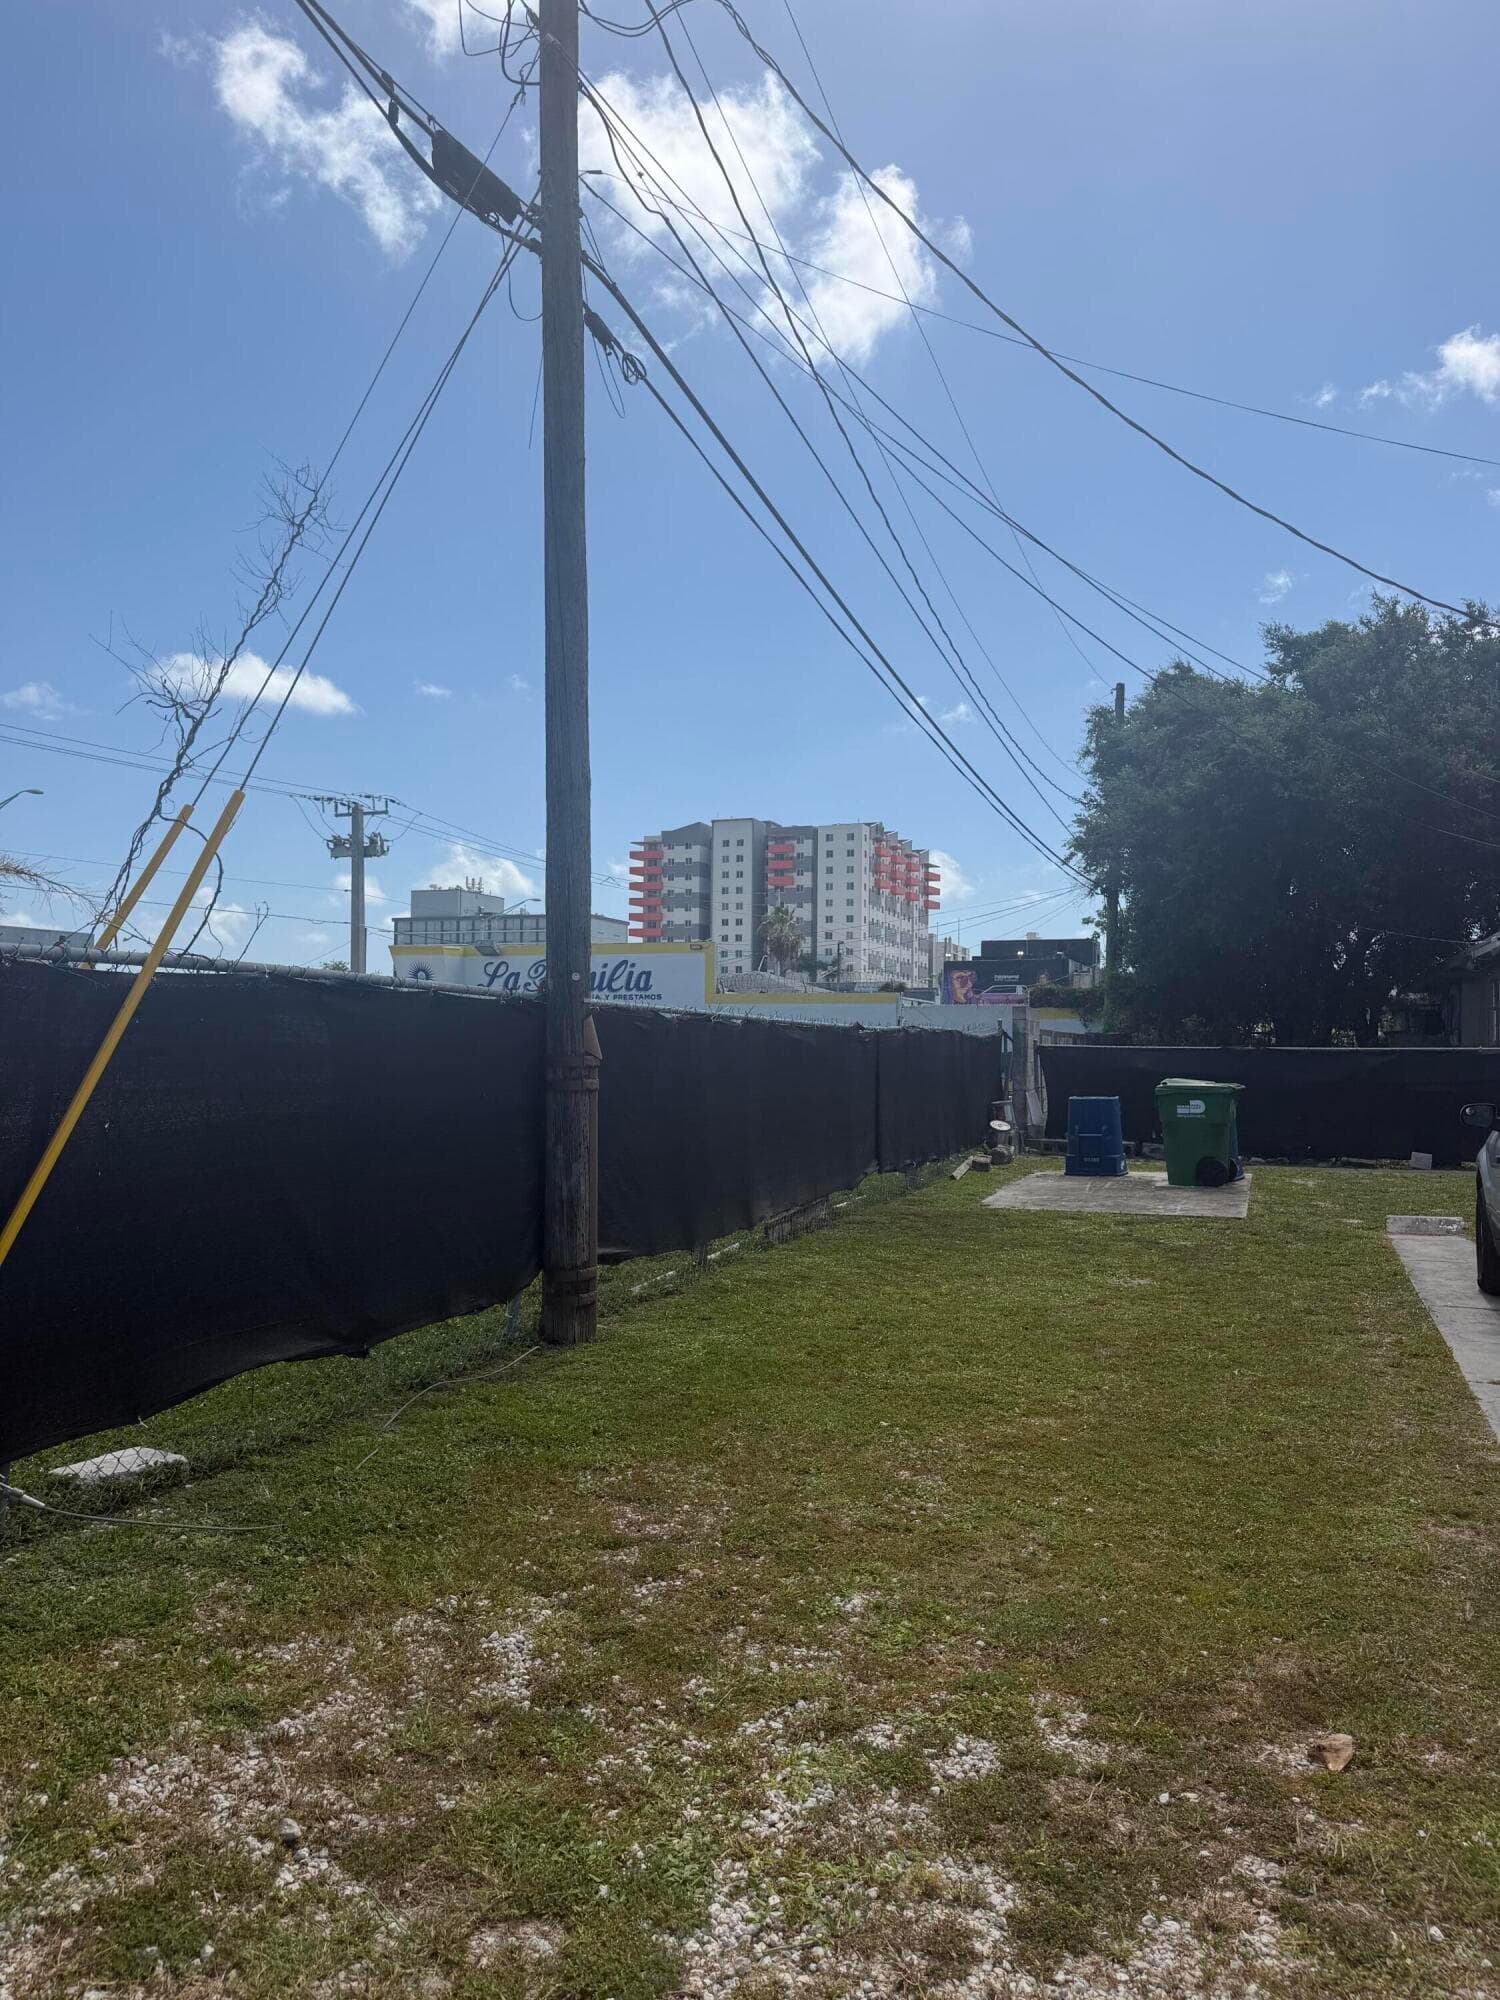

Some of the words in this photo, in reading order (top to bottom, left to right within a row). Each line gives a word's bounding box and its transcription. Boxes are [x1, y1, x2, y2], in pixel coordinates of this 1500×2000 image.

[477, 960, 521, 992] La
[605, 993, 610, 1001] Y
[612, 993, 663, 1001] PRESTAMOS
